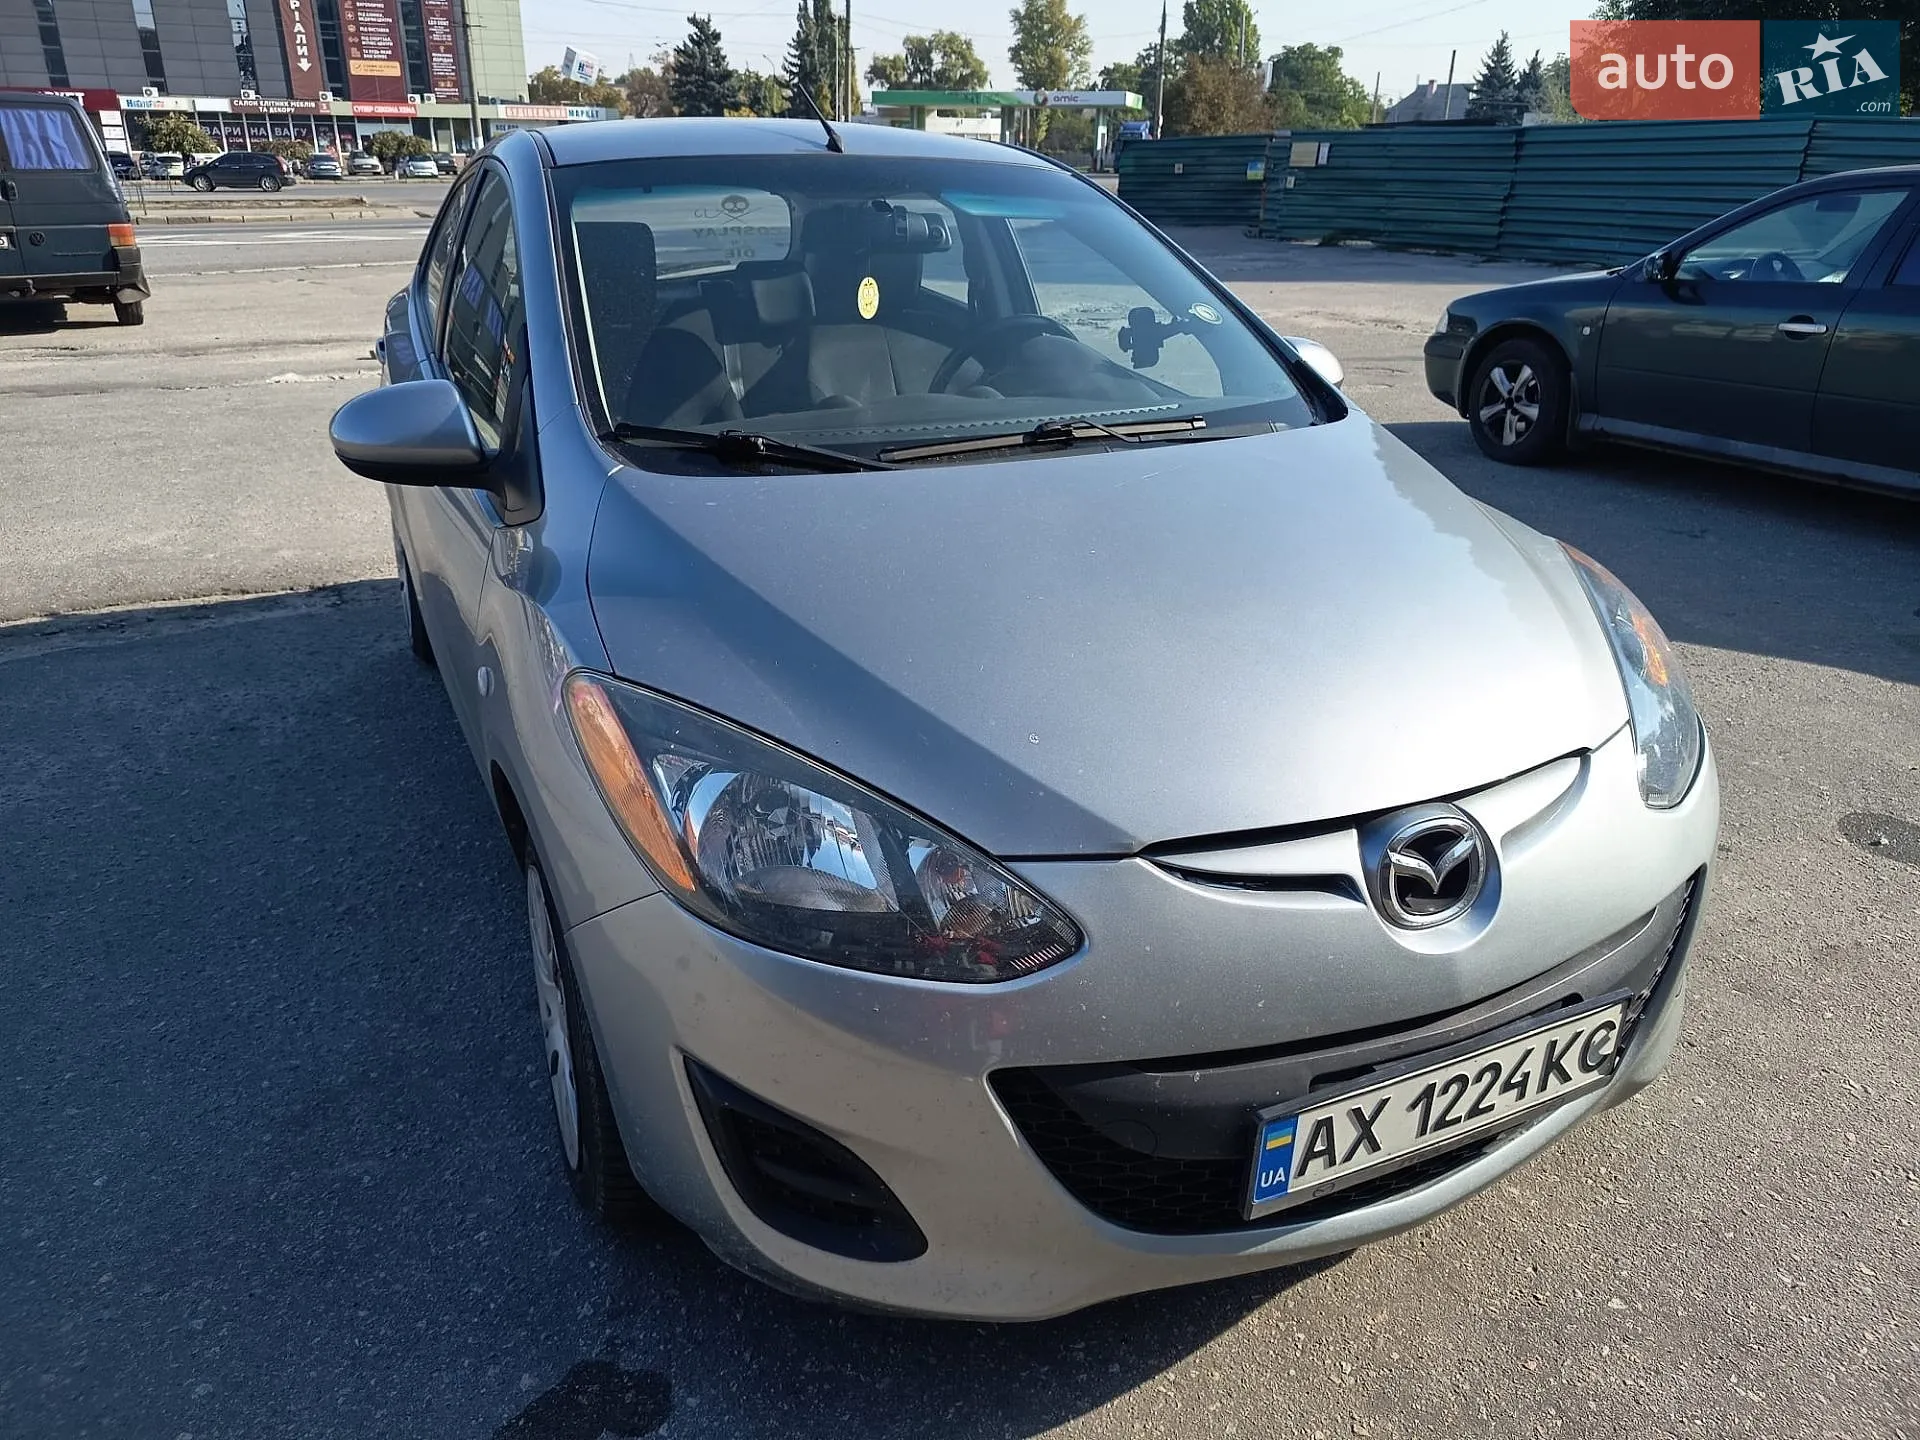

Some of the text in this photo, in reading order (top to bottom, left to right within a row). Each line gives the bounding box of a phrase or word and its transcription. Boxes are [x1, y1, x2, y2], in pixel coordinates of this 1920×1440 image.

[250, 127, 267, 136] НА
[1294, 1095, 1391, 1179] AX
[1260, 1165, 1287, 1188] UA
